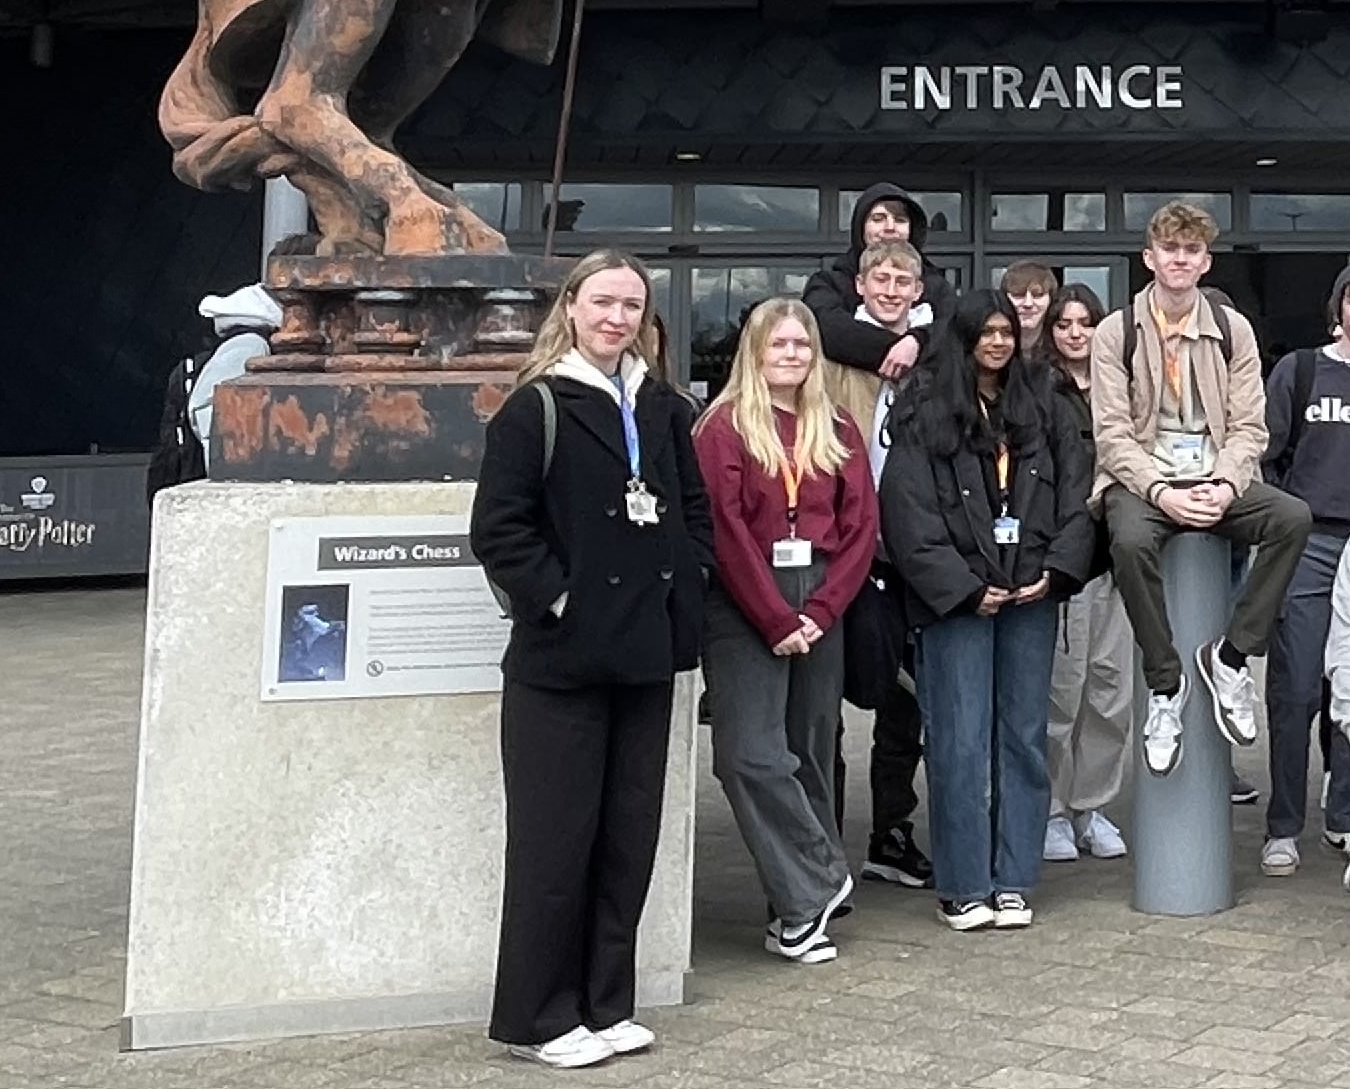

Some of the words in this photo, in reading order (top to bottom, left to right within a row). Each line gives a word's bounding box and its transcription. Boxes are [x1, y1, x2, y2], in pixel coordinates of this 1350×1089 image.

[879, 65, 1183, 110] ENTRANCE
[0, 522, 37, 551] arry
[38, 515, 96, 547] Potter
[333, 544, 407, 562] Wizard's
[411, 544, 460, 560] Chess
